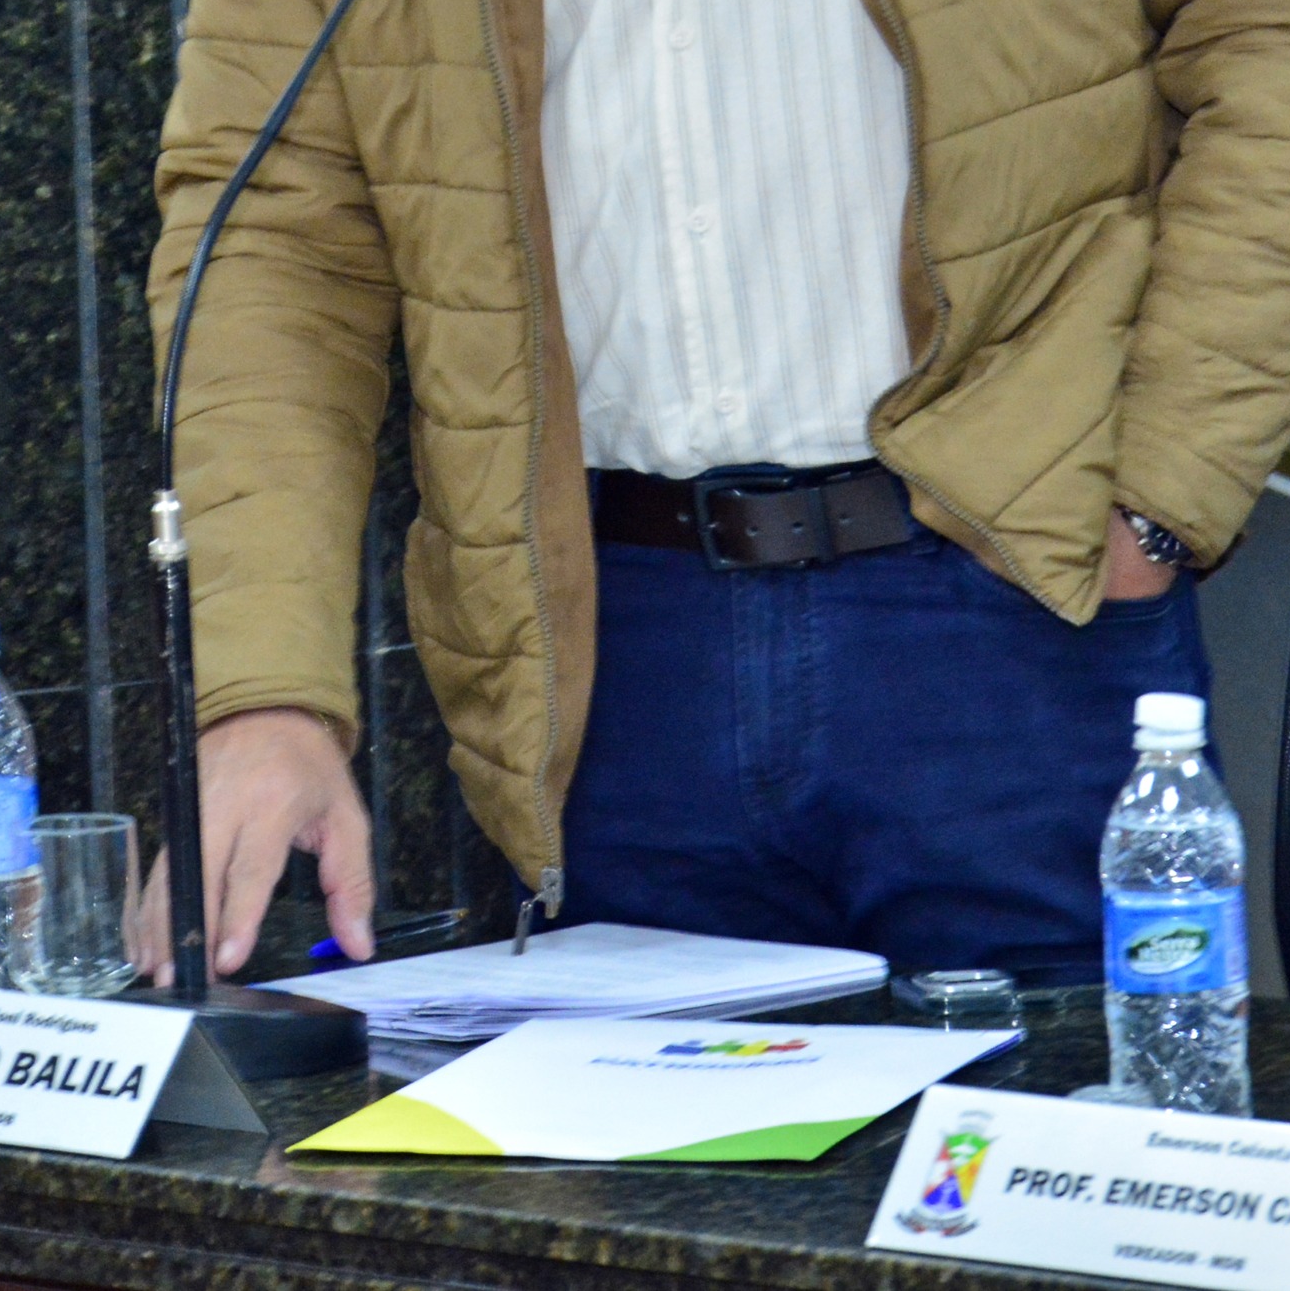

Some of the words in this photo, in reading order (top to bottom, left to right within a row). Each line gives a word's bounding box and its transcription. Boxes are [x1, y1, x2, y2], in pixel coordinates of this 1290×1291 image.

[6, 1051, 147, 1100] BALILA
[1147, 1131, 1223, 1155] Emerson
[1005, 1167, 1094, 1203] PROF.
[1103, 1177, 1262, 1222] EMERSON
[1114, 1244, 1199, 1267] VEREADOR
